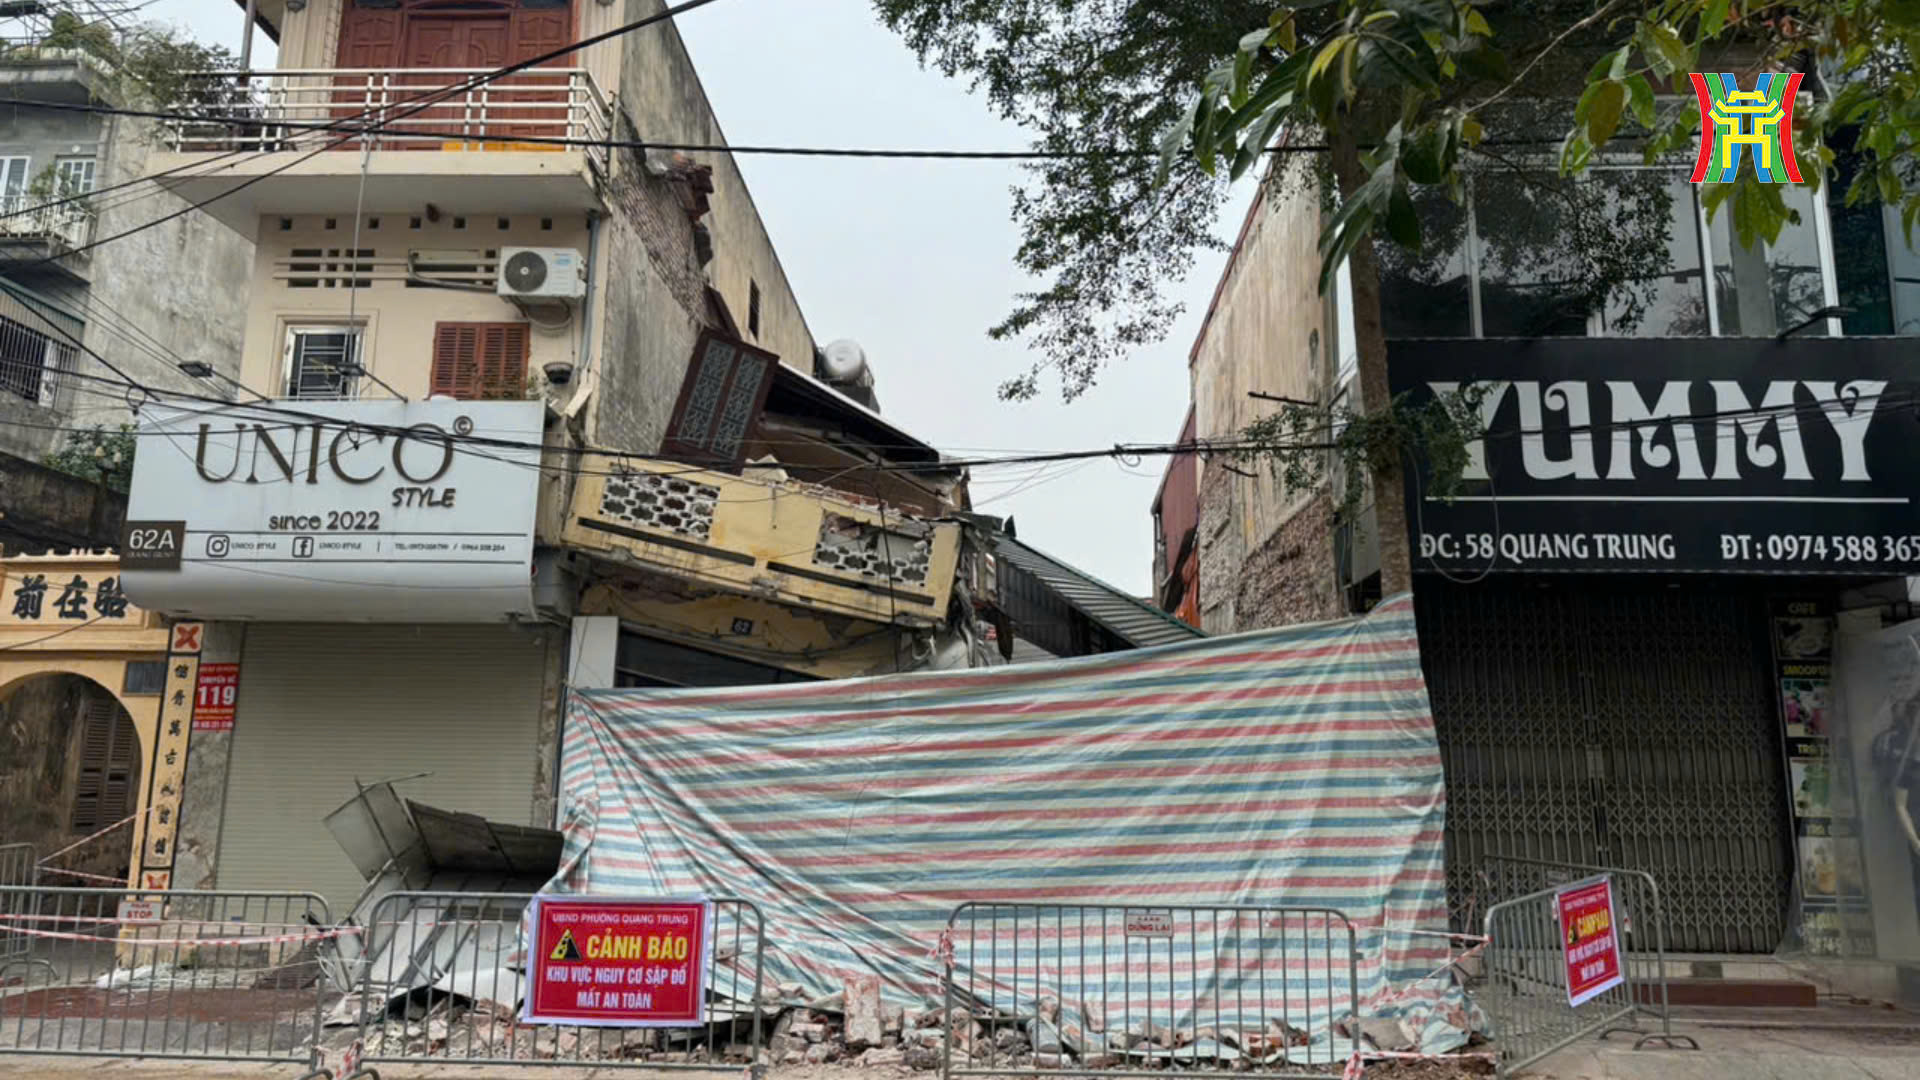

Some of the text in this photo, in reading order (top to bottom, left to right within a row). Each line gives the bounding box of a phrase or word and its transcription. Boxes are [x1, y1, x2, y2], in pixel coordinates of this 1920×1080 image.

[1426, 380, 1889, 481] YUMMY
[195, 422, 453, 484] UNICO
[391, 487, 456, 508] STYLE
[268, 511, 380, 531] since 2022
[129, 529, 175, 550] 62A
[1465, 533, 1495, 559] 58
[1500, 533, 1589, 564] QUANG
[1592, 533, 1677, 560] TRUNG
[1766, 534, 1829, 562] 0974
[1831, 535, 1878, 562] 588
[198, 685, 236, 706] 119
[127, 910, 153, 919] STOP
[552, 913, 579, 923] UBND
[622, 914, 654, 925] QUANG
[657, 914, 689, 925] TRUNG
[586, 927, 688, 961] CẢNH BÁO
[546, 965, 568, 982] KHU
[595, 967, 625, 983] NGUY
[602, 991, 619, 1008] AN
[622, 989, 652, 1009] TOÀN
